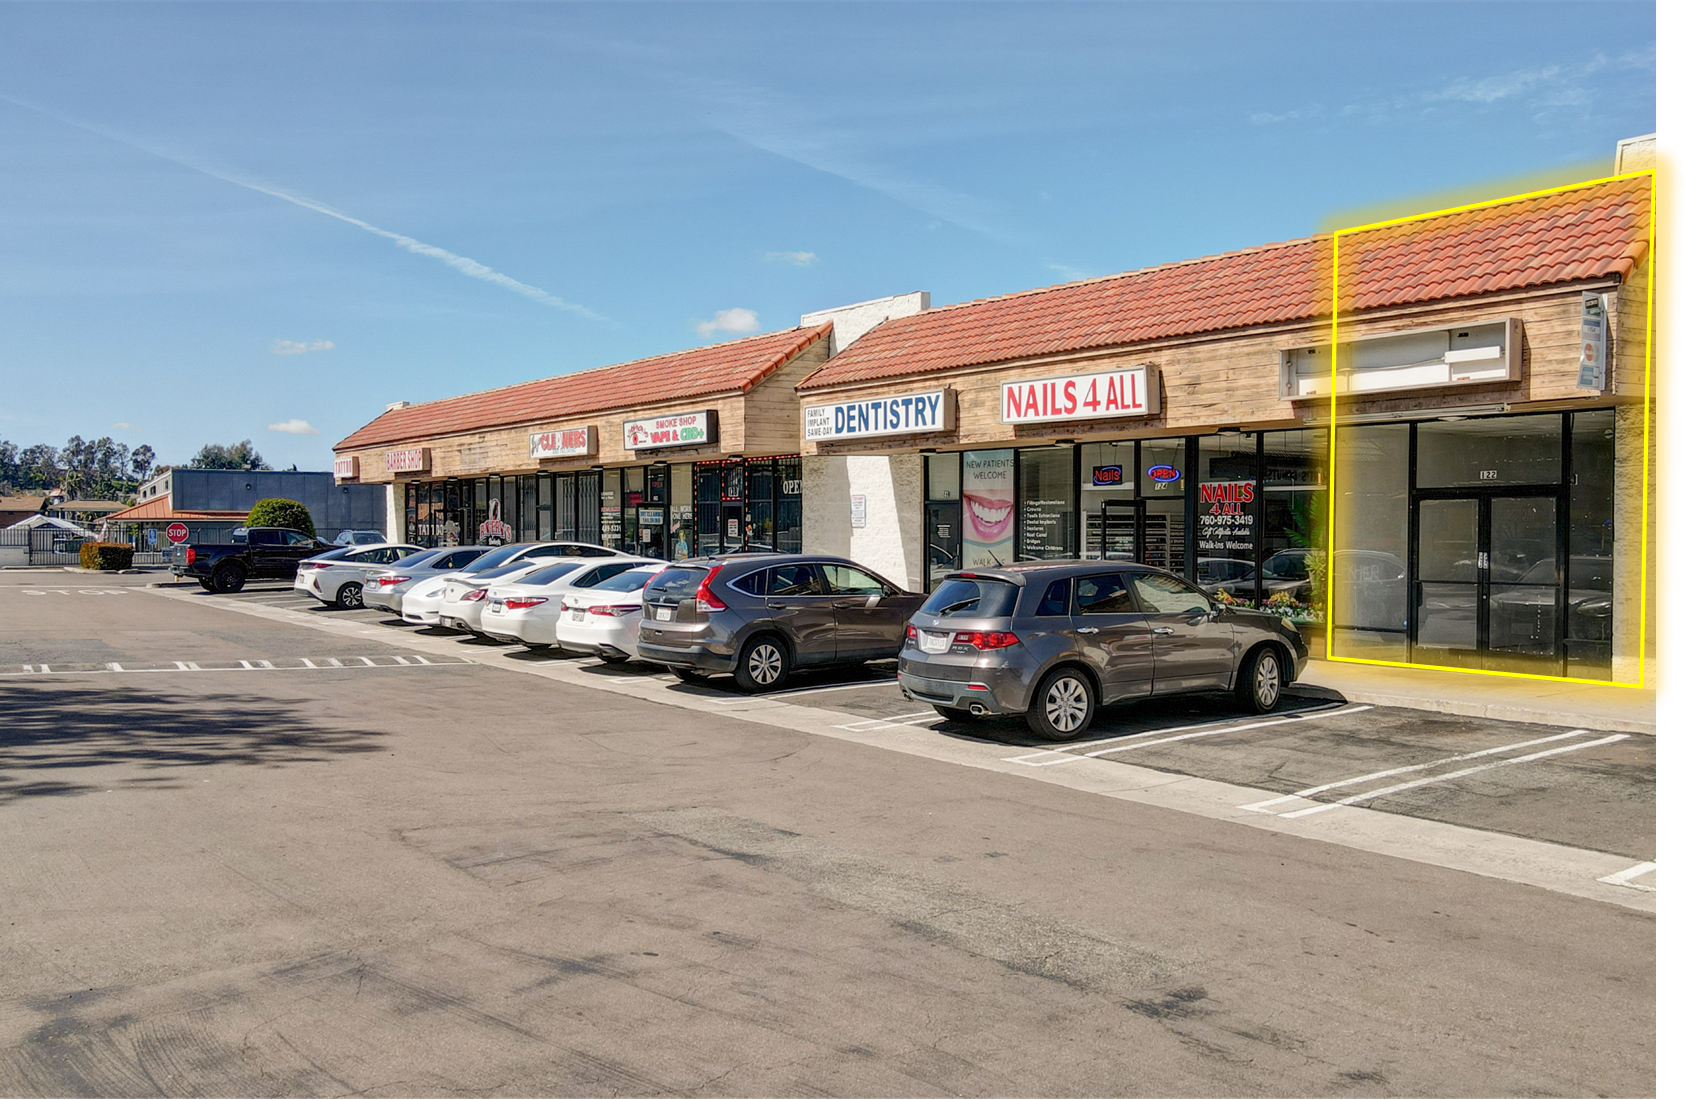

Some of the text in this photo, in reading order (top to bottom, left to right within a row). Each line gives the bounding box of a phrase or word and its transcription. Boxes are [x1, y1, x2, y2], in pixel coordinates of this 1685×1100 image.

[1006, 374, 1142, 418] NAILS 4 ALL
[807, 408, 825, 418] FAMILY
[835, 394, 940, 434] DENTISTRY
[656, 416, 697, 429] SMOKE SHOP
[807, 417, 829, 427] IMPLANT
[650, 431, 670, 443] VAPE
[672, 429, 679, 441] &
[680, 427, 704, 440] CBD+
[807, 427, 832, 436] SAME-DAY
[540, 430, 586, 451] CLEANERS
[387, 450, 422, 471] BARBER SHOP
[966, 459, 1014, 469] NEW PATIENTS
[335, 460, 352, 474] TATTOO
[973, 471, 1007, 479] WELCOME
[1095, 470, 1120, 481] Nails
[1150, 469, 1176, 479] OPEN
[1482, 471, 1496, 479] 122
[1200, 483, 1254, 503] NAILS
[1209, 503, 1244, 515] 4 ALL
[1200, 515, 1253, 525] 760-975-3419
[168, 529, 187, 537] STOP
[1225, 540, 1253, 550] Welcome
